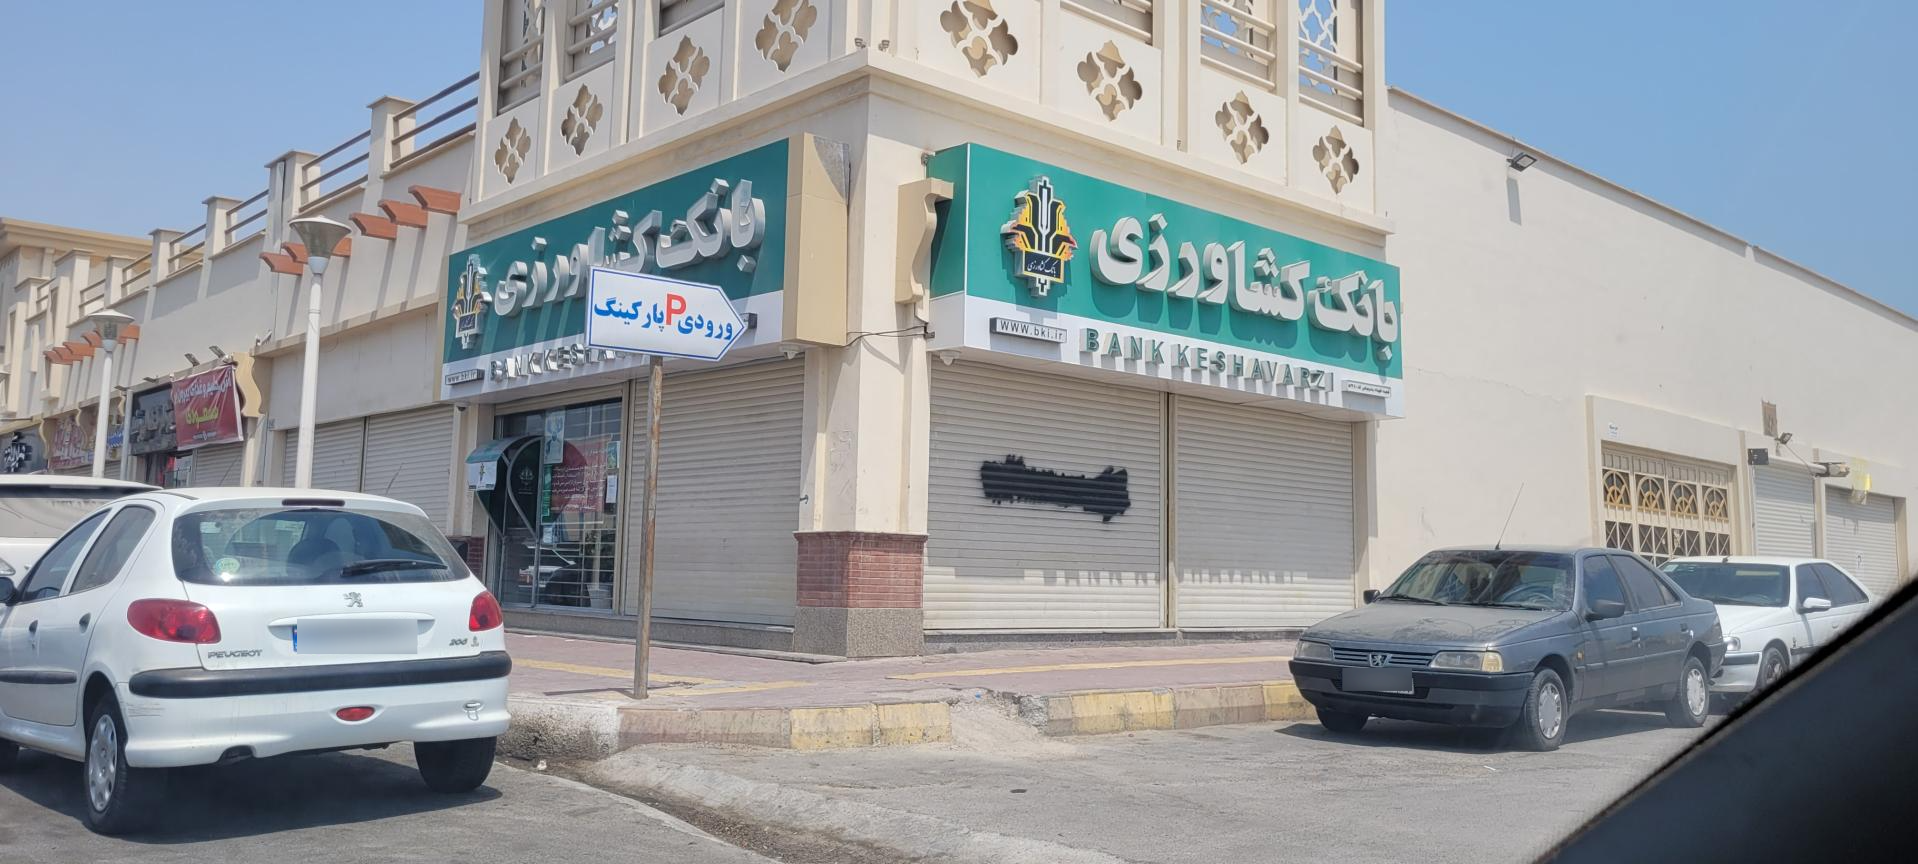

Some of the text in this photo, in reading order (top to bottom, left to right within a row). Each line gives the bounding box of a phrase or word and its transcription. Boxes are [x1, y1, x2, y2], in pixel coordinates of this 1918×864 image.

[656, 178, 766, 273] بانک
[1089, 213, 1398, 360] بانک کشاورزی
[594, 297, 664, 333] پارکینگ
[665, 293, 687, 326] P
[677, 314, 733, 341] ورودی
[490, 352, 542, 381] BANK
[1080, 327, 1334, 392] BANK KESHAVARZI
[207, 649, 263, 659] PEUGEOT
[449, 638, 468, 646] 206
